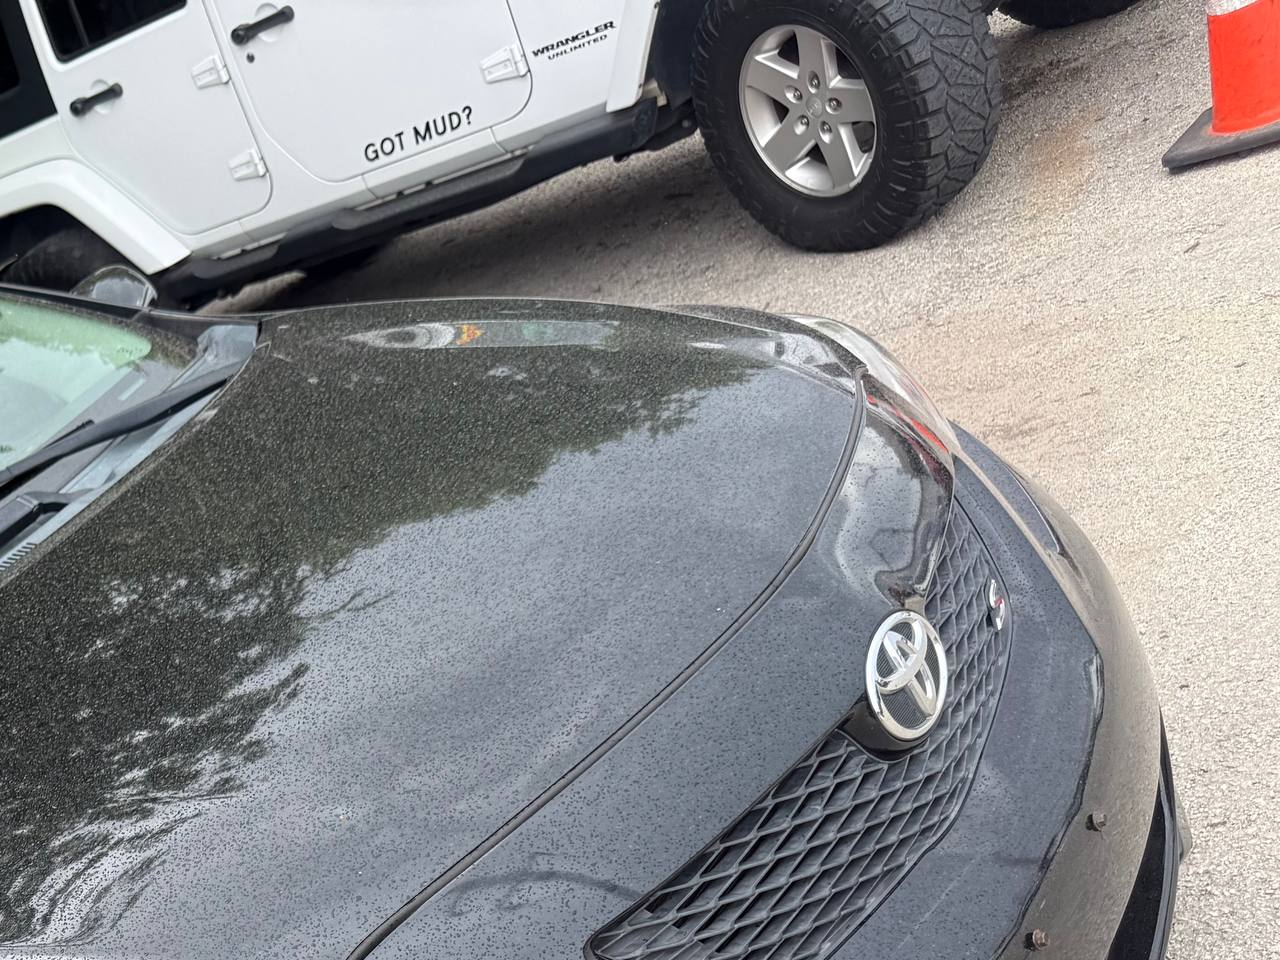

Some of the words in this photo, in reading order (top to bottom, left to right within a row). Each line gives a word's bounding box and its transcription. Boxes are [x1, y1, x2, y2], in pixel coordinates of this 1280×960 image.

[532, 20, 616, 57] WRANGLER
[548, 33, 607, 60] UNLIMITED
[364, 131, 405, 162] GOT
[412, 105, 473, 145] MUD?
